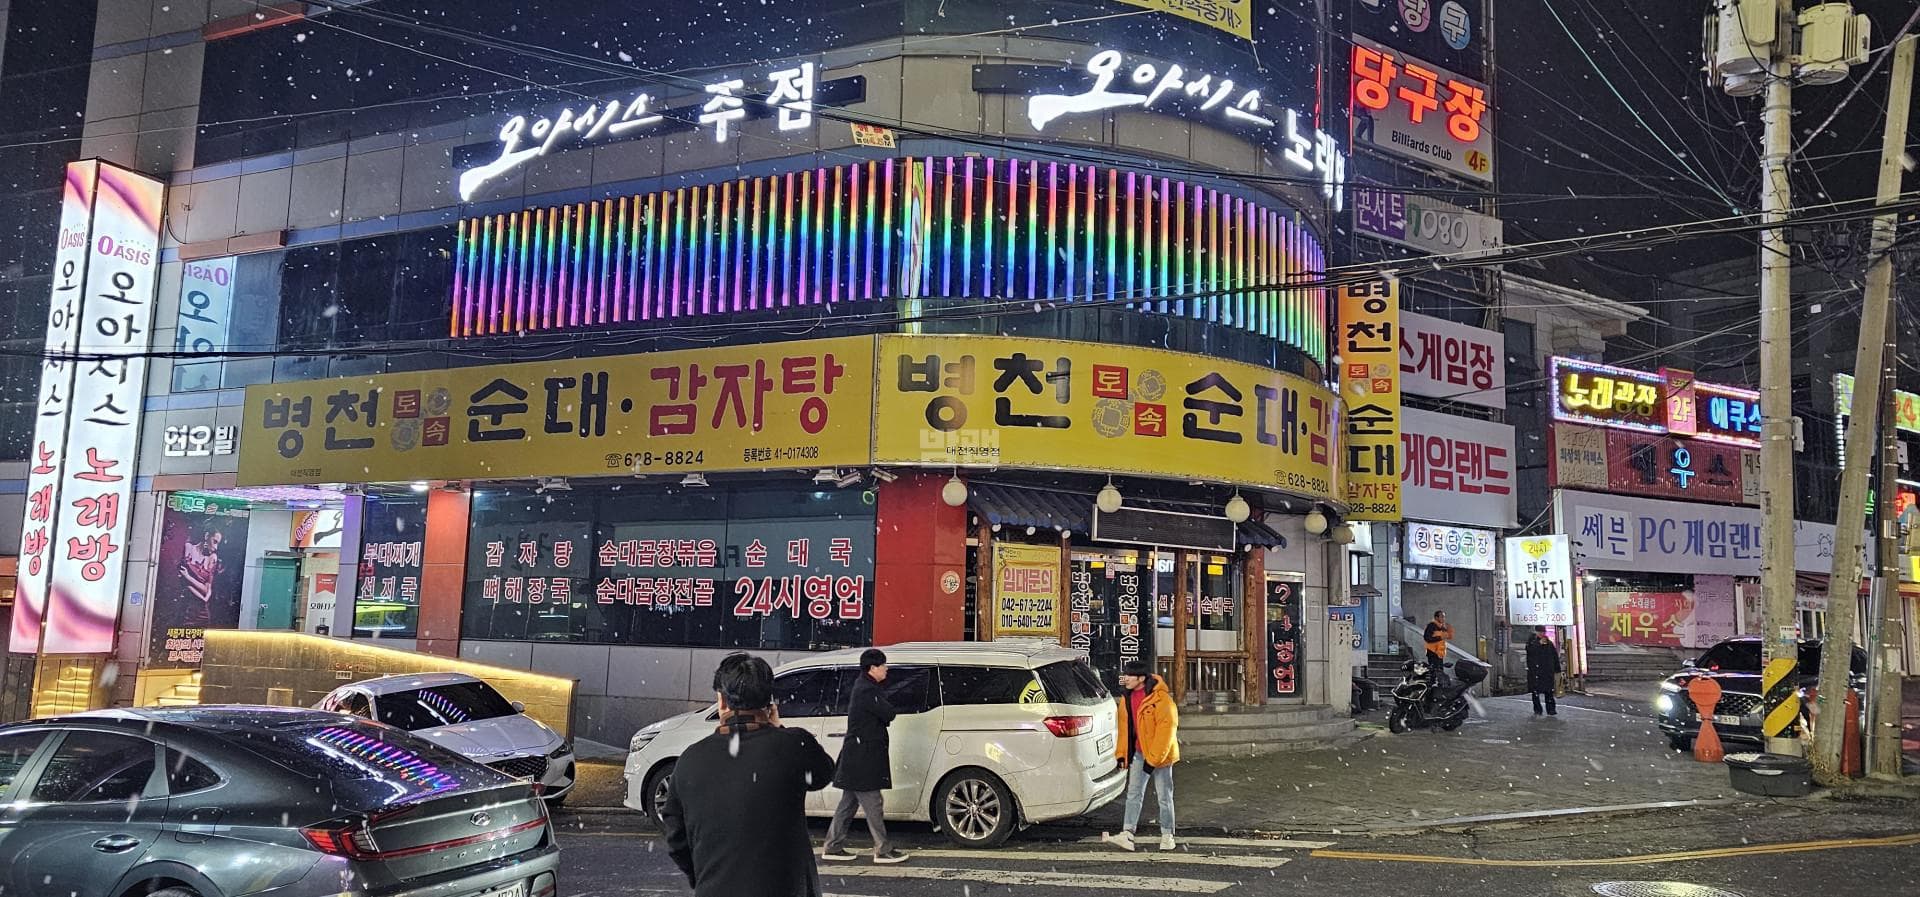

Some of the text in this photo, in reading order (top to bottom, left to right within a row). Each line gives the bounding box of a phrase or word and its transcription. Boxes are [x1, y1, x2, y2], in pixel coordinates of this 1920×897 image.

[1028, 50, 1274, 131] 오아시스
[1354, 45, 1486, 142] 당구장
[459, 62, 814, 201] 오아시스 주점
[1391, 130, 1452, 161] Billiards Club
[1468, 150, 1486, 172] 4F
[61, 228, 86, 250] OASIS
[1407, 203, 1468, 249] 7080
[97, 235, 150, 266] OASIS
[1346, 280, 1393, 353] 병천
[41, 260, 78, 417] 오아시스
[83, 271, 145, 426] 오아시스
[898, 352, 1072, 432] 병천
[1566, 373, 1658, 417] 노래광장
[263, 389, 380, 459] 병천
[396, 394, 446, 442] 토속
[1672, 397, 1693, 422] 2F
[743, 446, 819, 463] 등록번호 41-0174308
[1348, 403, 1395, 476] 순대
[1400, 433, 1511, 495] 게임랜드
[1288, 472, 1329, 494] 628-8824
[23, 440, 57, 577] 노래방
[67, 446, 125, 583] 노래방
[1416, 530, 1488, 556] 킹덤당구장
[1528, 541, 1548, 554] 24시
[1582, 512, 1761, 560] 쎄븐 PC 게임랜
[363, 541, 421, 567] 부대찌개
[598, 538, 717, 568] 순대곱창볶음
[1527, 559, 1550, 574] 태유
[1003, 567, 1053, 594] 임대문의
[1119, 574, 1139, 614] 병천
[1515, 579, 1565, 599] 마사지
[596, 577, 715, 606] 순대곱창전골
[733, 574, 865, 620] 24시영업
[1002, 597, 1053, 612] 042-673-2244
[1201, 595, 1235, 617] 순대국
[1534, 602, 1548, 612] 5F
[1001, 614, 1052, 628] 010-6401-2244
[1609, 612, 1685, 639] 제우스
